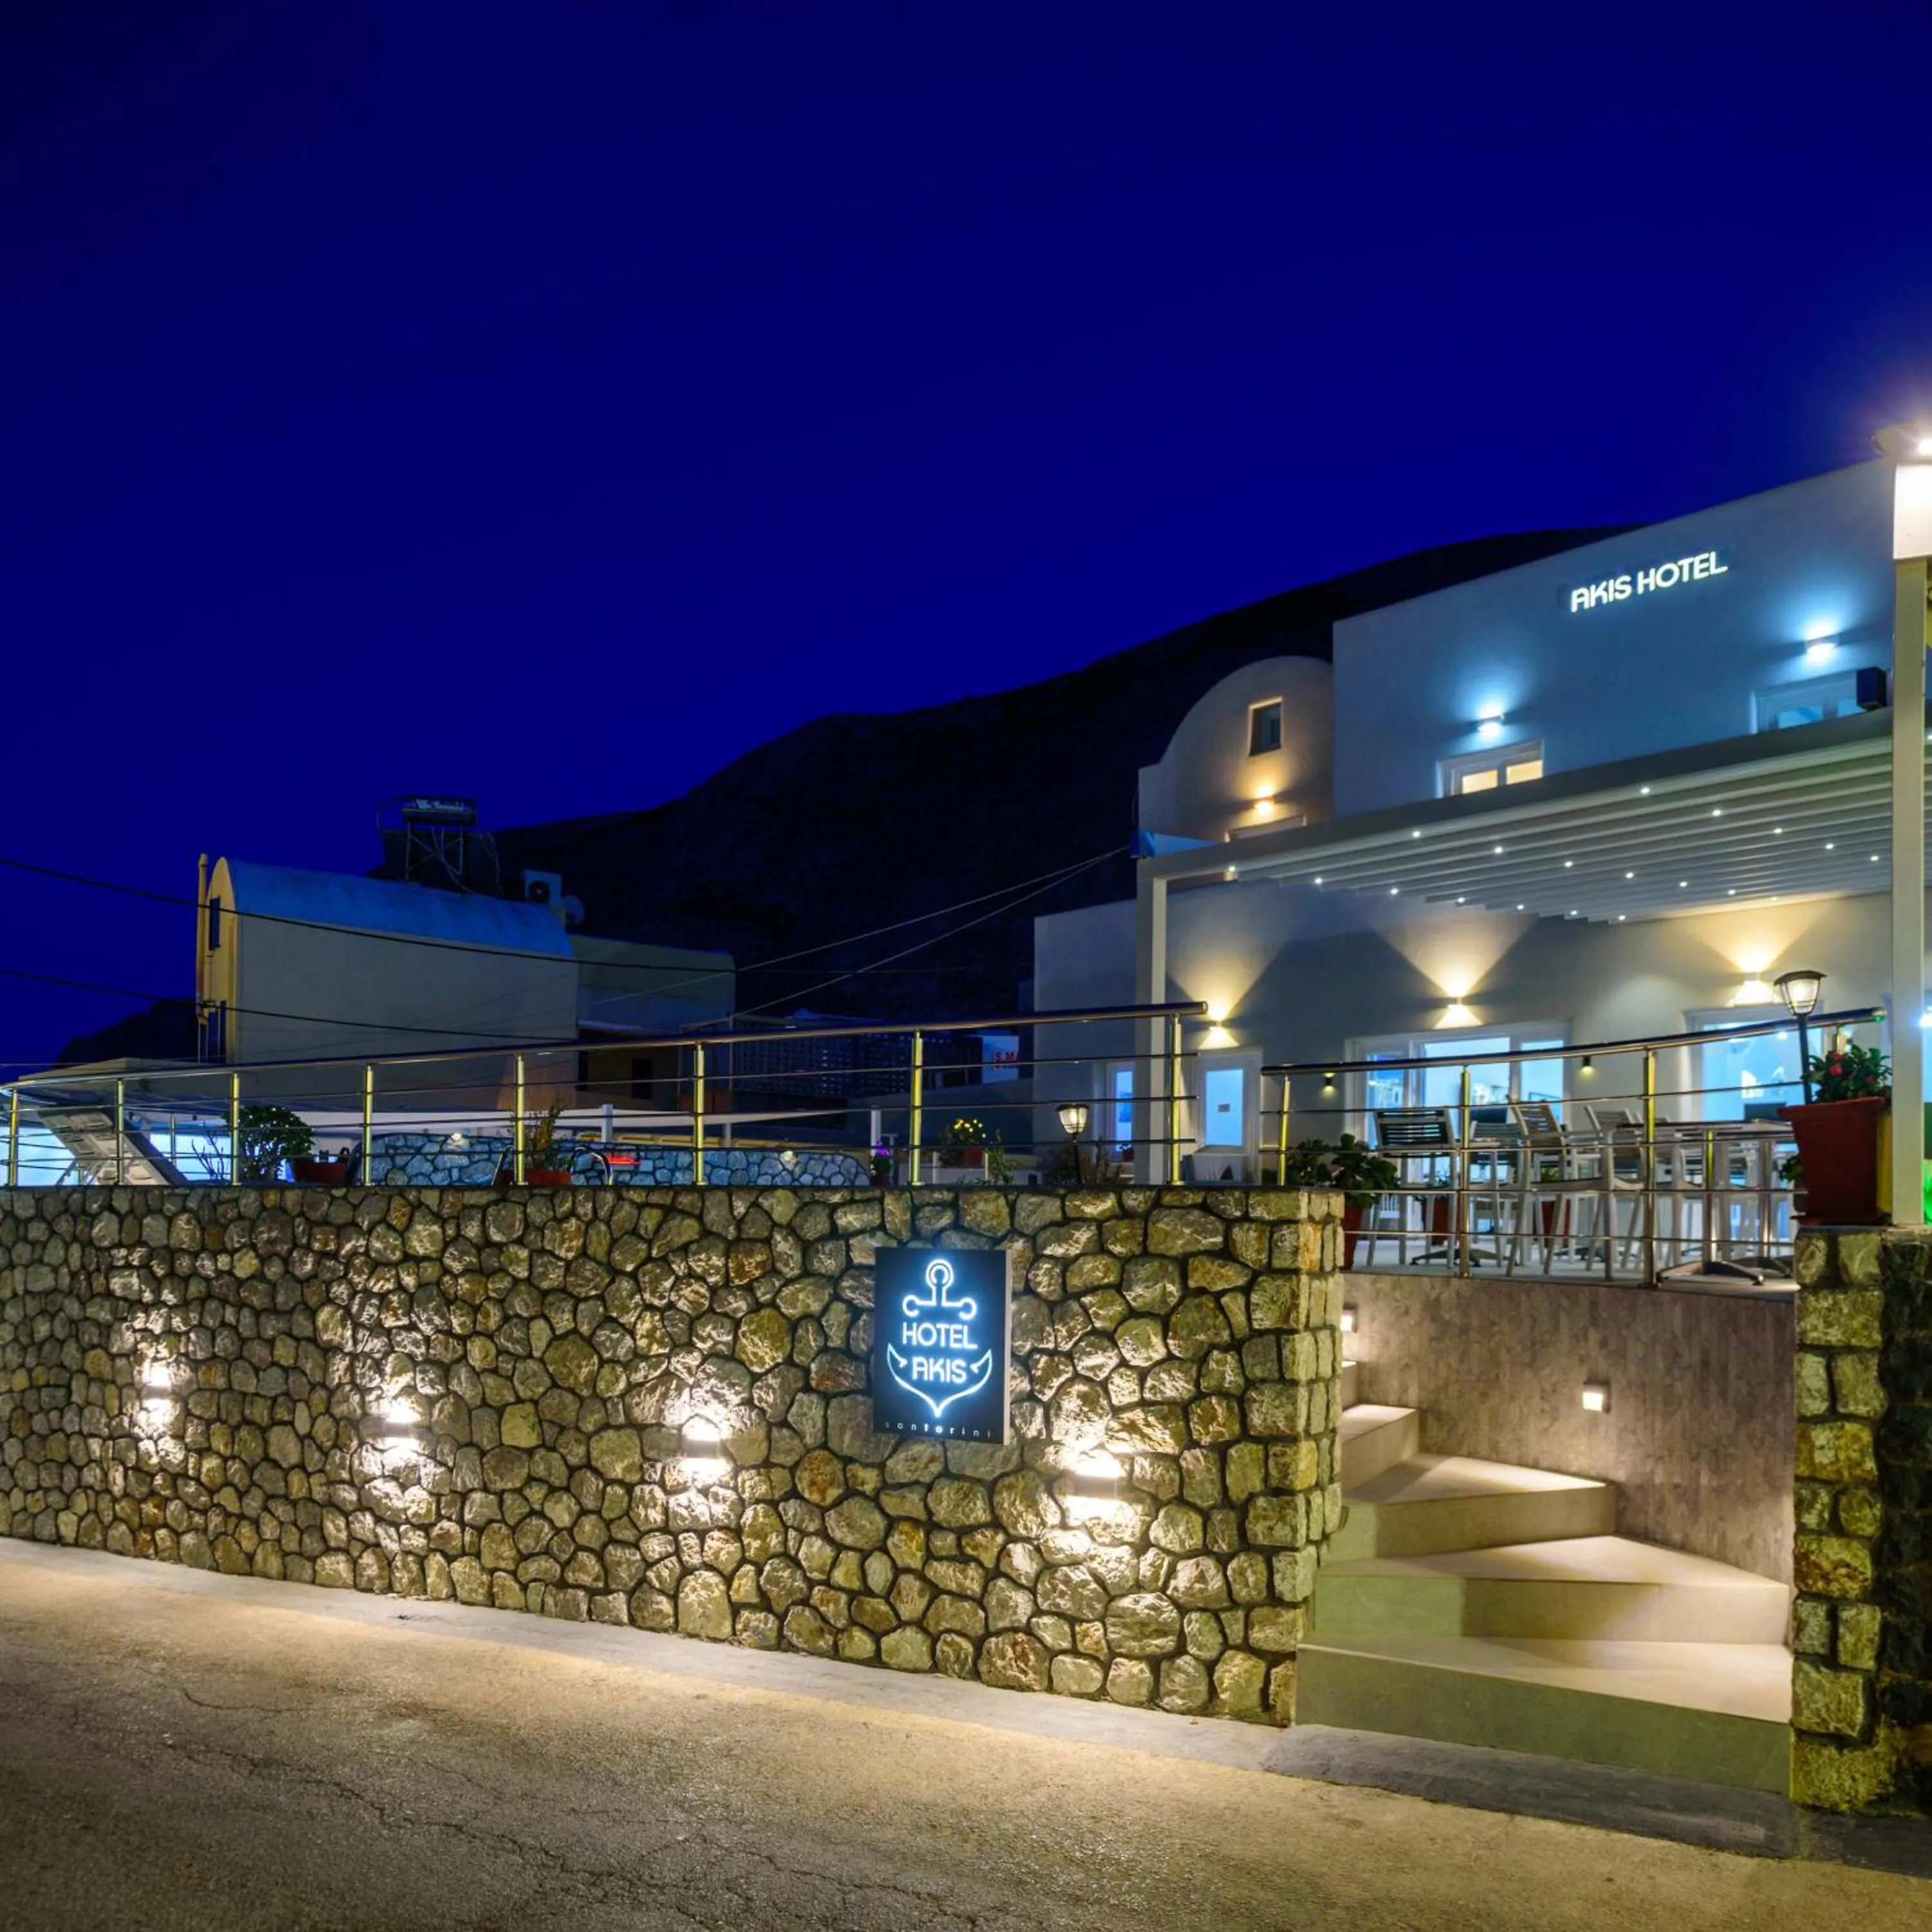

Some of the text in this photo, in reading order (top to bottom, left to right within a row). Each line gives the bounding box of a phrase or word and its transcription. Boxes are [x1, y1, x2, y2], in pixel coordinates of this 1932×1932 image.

[1571, 551, 1728, 612] AKIS HOTEL
[902, 1322, 978, 1349] HOTEL
[911, 1356, 967, 1384] AKIS
